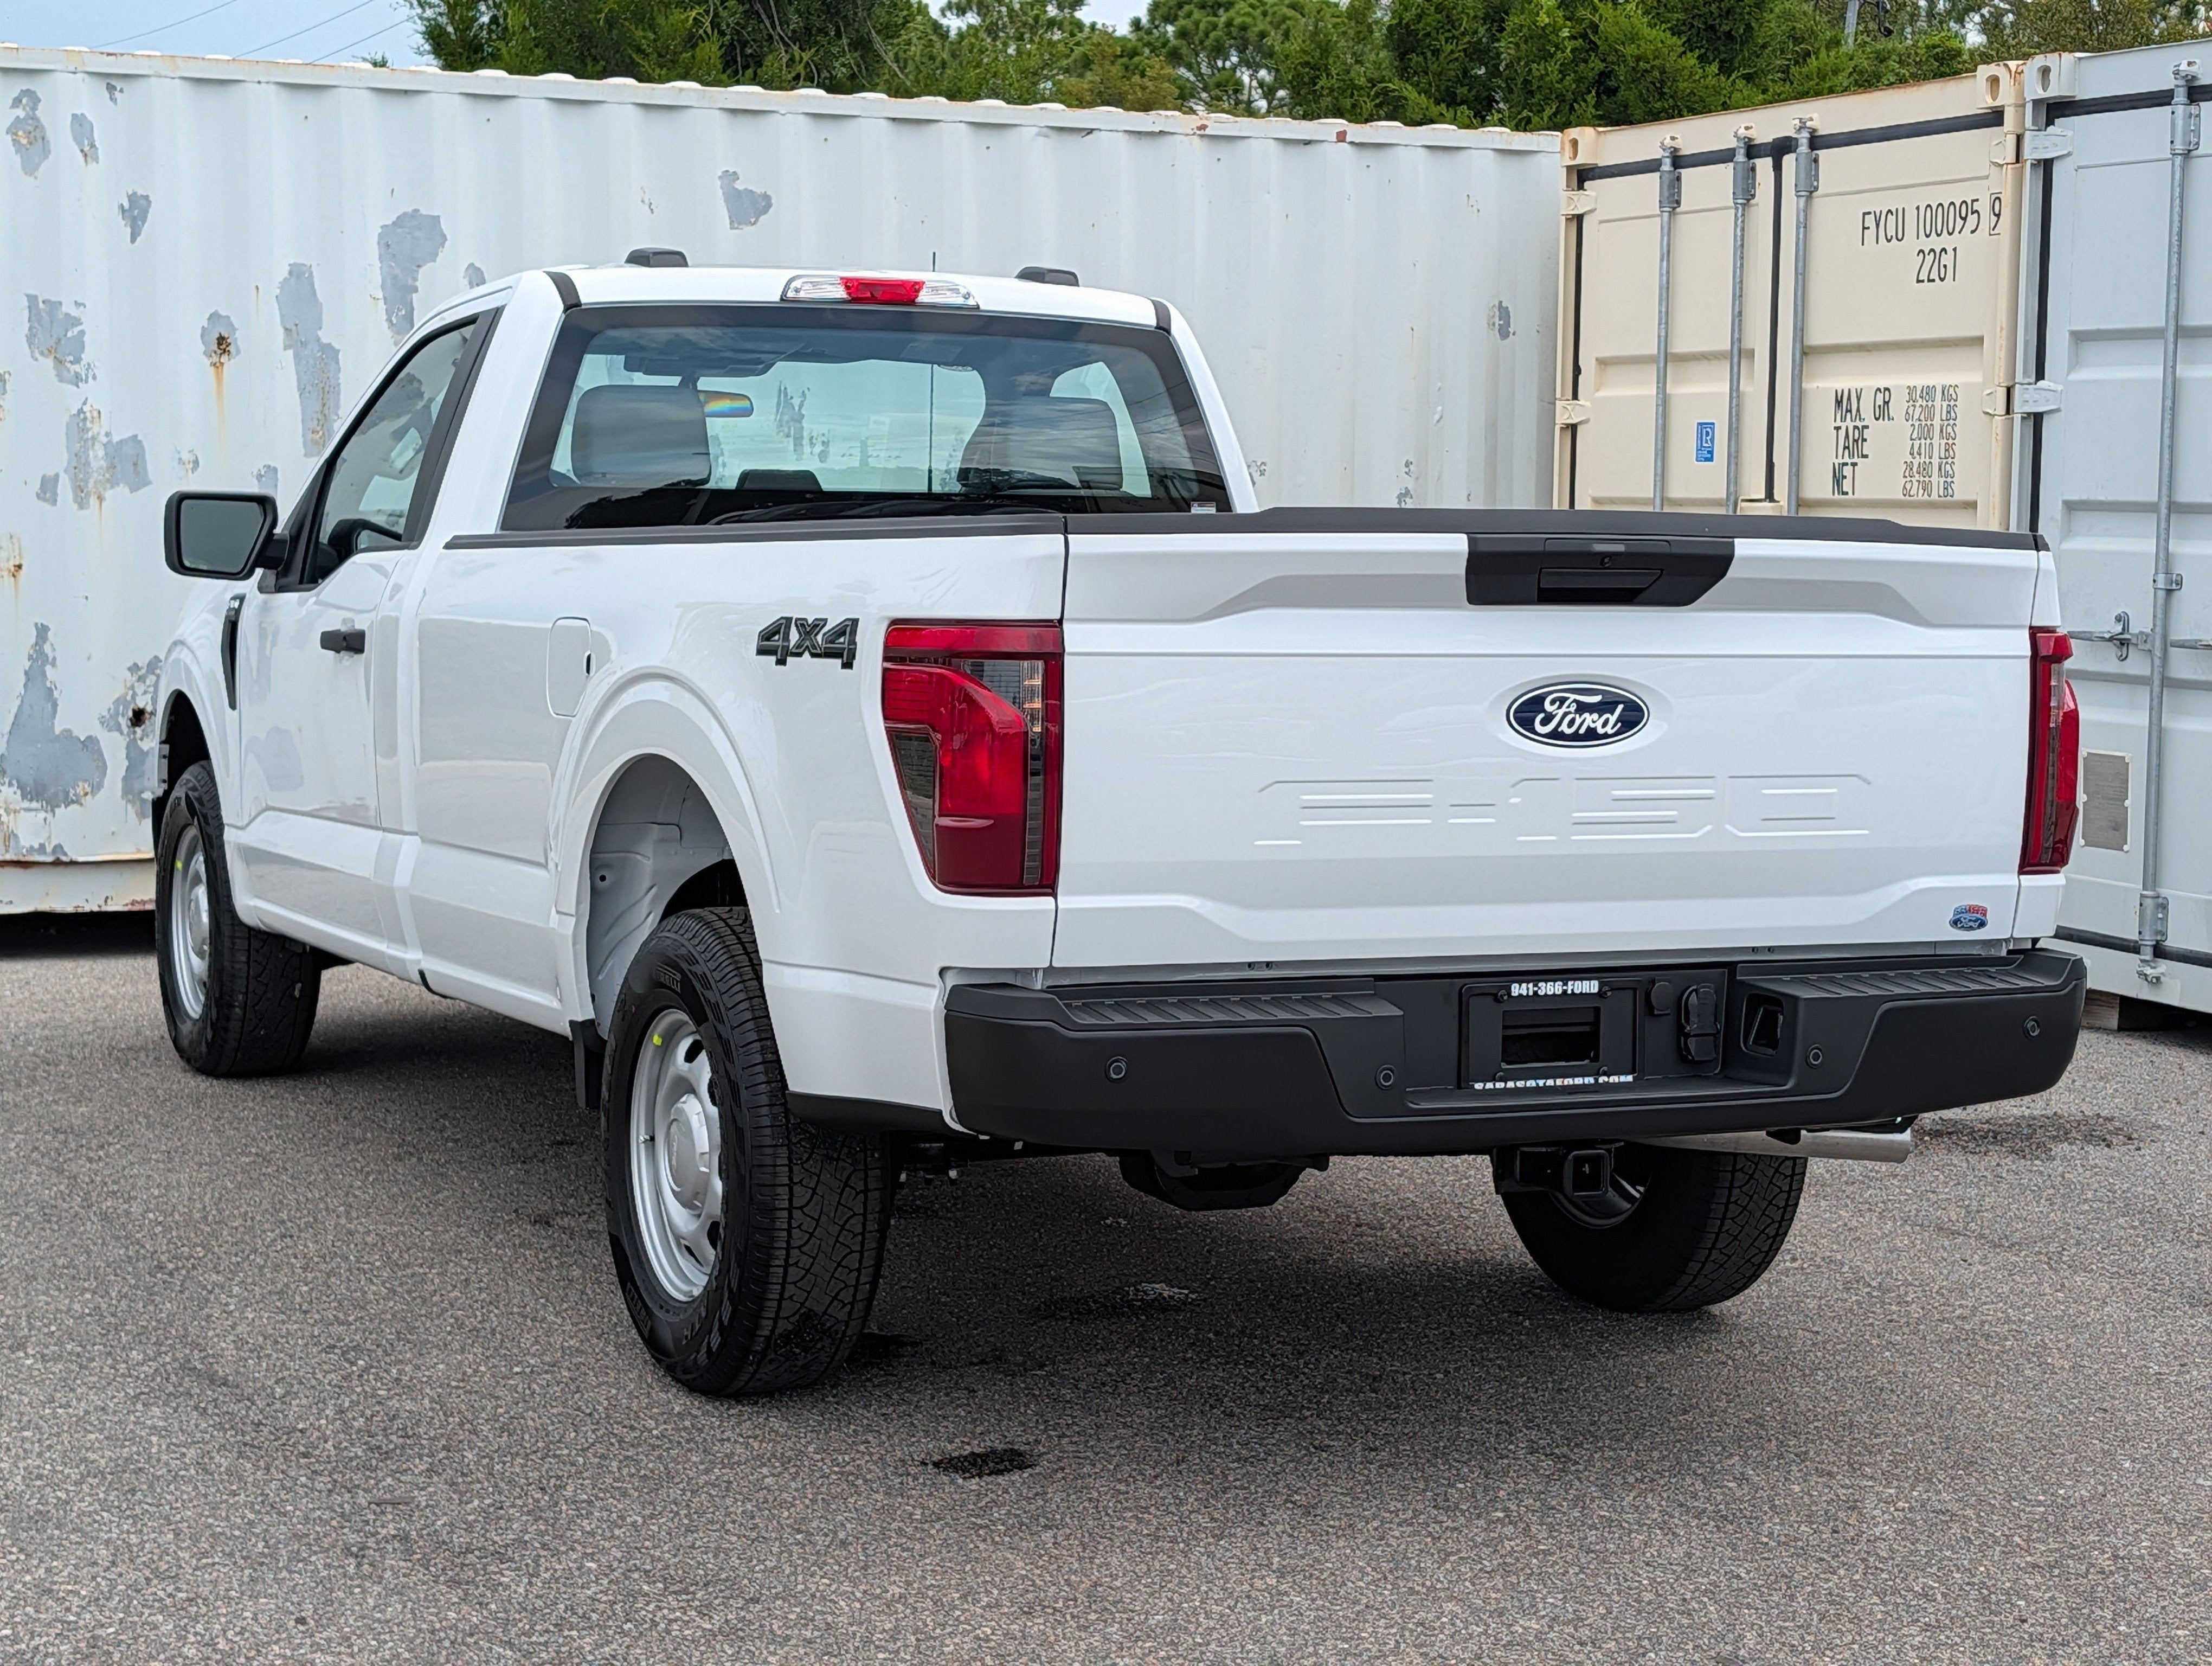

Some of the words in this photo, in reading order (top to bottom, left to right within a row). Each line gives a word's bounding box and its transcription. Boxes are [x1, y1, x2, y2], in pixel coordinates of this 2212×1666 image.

[1861, 207, 1905, 246] FYCU
[1915, 198, 1980, 240] 100095
[1992, 196, 2002, 231] 9
[1915, 246, 1957, 284] 22G1
[1941, 384, 1959, 402] KGS
[1834, 388, 1865, 423] MAX.
[1873, 387, 1894, 421] GR.
[1939, 403, 1958, 421] LBS
[1939, 422, 1957, 441] KGS
[1834, 425, 1869, 459] TARE
[1938, 442, 1957, 459] LBS
[1938, 460, 1955, 478] KGS
[1832, 462, 1858, 496] NET
[1937, 480, 1955, 498] LBS
[1534, 693, 1624, 734] Ford
[1510, 979, 1599, 997] 941-366-FORD
